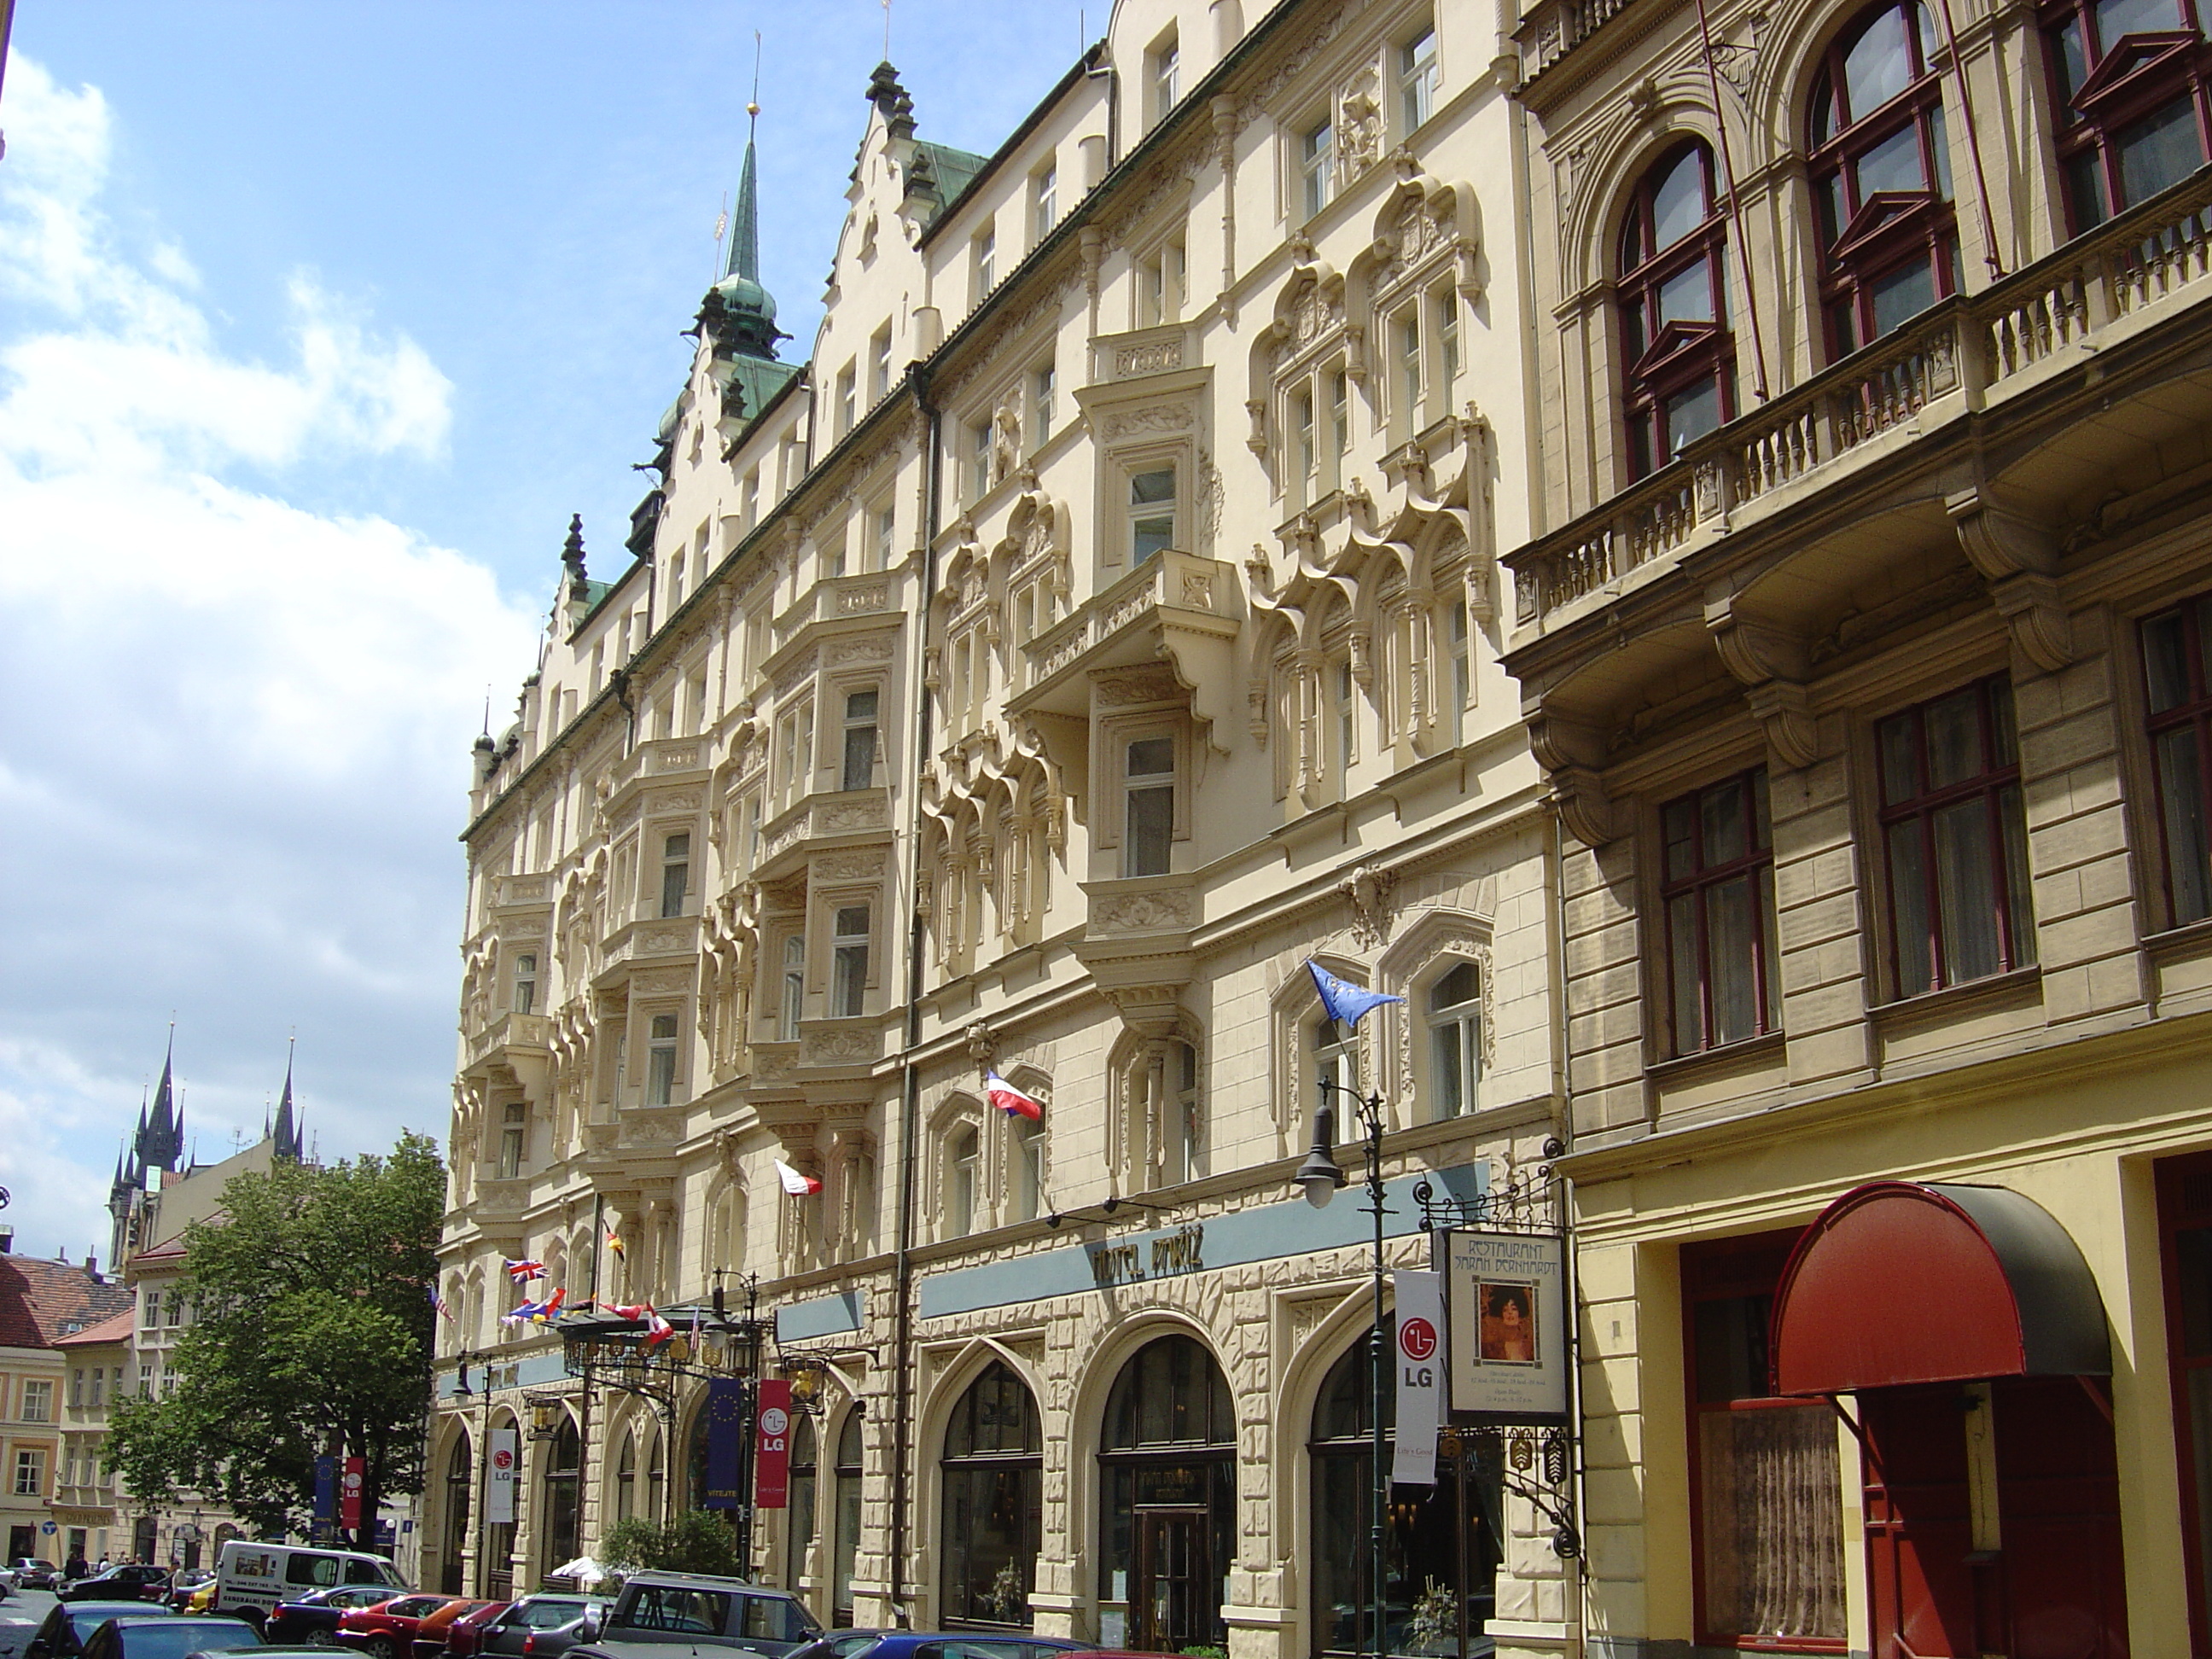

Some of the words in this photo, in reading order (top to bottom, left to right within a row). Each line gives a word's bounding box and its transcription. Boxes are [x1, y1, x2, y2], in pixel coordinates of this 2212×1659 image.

[1469, 1240, 1545, 1260] RESTAURANT
[1454, 1255, 1490, 1272] SARAH
[1495, 1259, 1557, 1275] BERNHARDT
[1405, 1367, 1433, 1388] LG
[764, 1438, 784, 1451] LG
[496, 1472, 509, 1481] LG
[346, 1489, 359, 1498] LG
